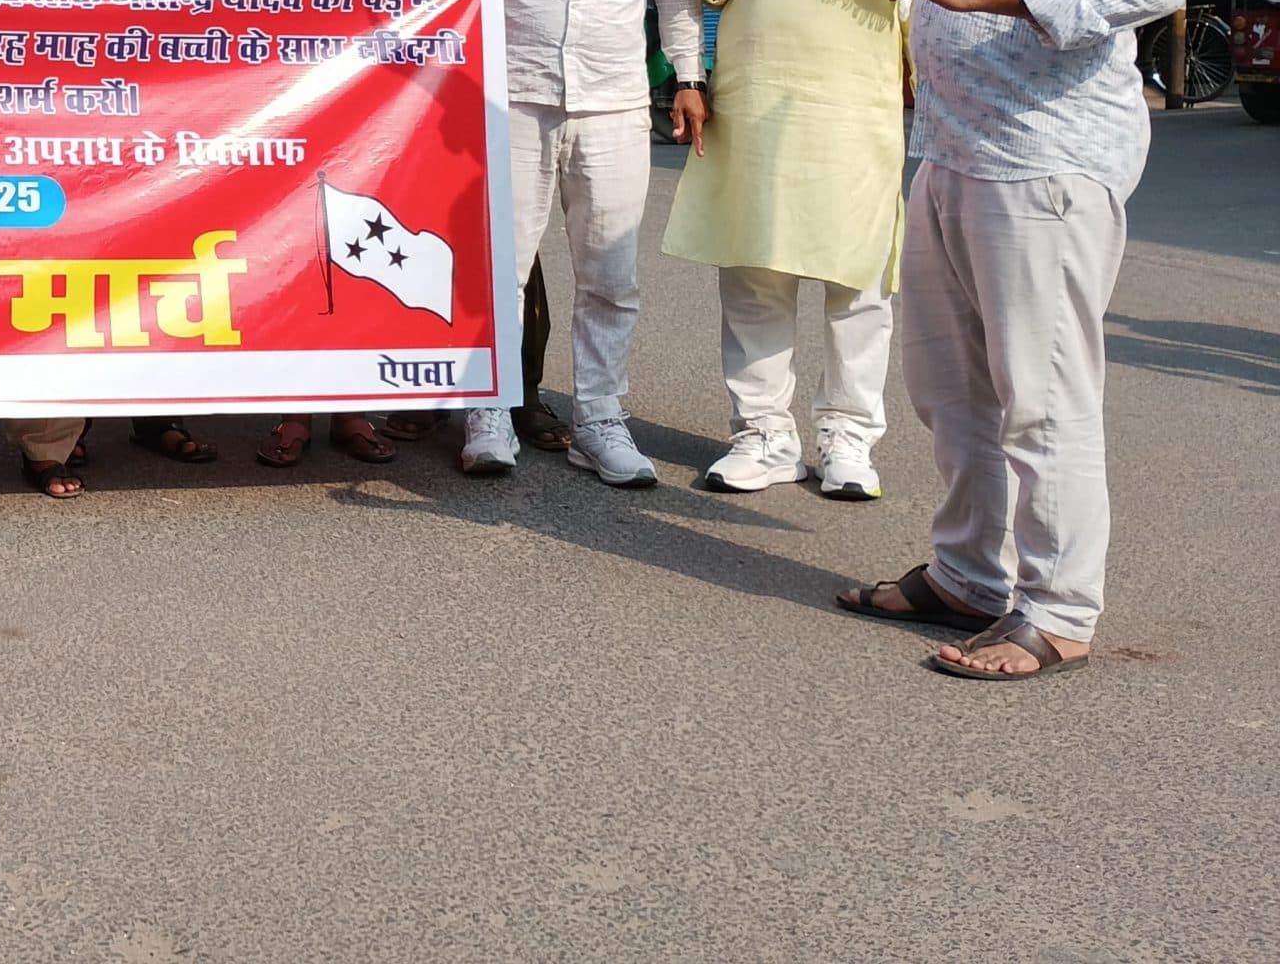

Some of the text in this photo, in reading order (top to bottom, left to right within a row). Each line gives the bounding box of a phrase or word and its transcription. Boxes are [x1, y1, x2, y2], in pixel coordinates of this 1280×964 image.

[33, 32, 100, 67] माह
[104, 26, 154, 62] की
[158, 26, 232, 63] बच्ची
[237, 27, 271, 63] के
[276, 33, 348, 64] साथ
[4, 135, 129, 166] अपराध
[131, 130, 167, 165] के
[376, 353, 457, 387] ऐपवा
